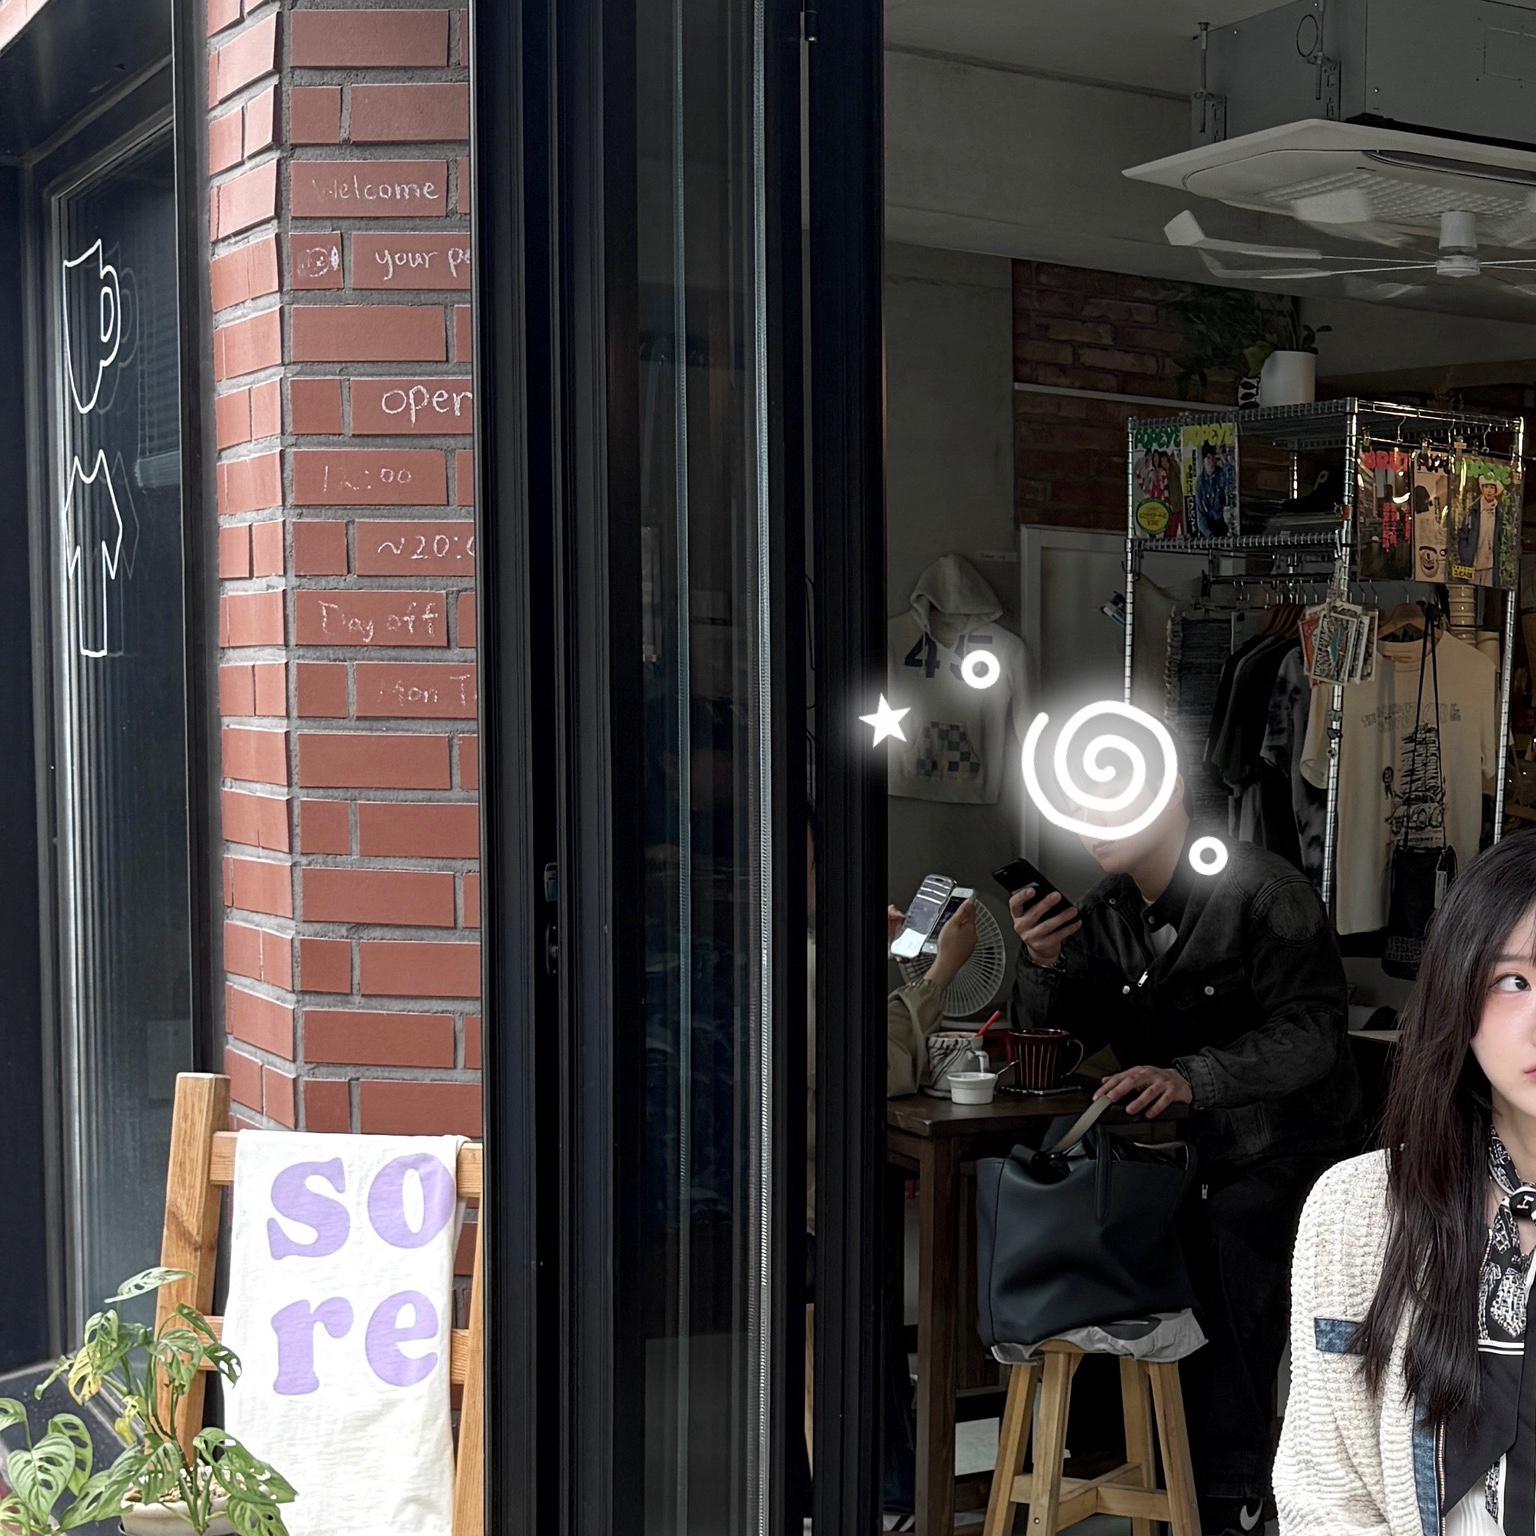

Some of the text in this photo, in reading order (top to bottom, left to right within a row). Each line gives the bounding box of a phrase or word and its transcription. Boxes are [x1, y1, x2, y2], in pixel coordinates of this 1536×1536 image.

[375, 249, 438, 281] your
[266, 1153, 457, 1261] so
[270, 1289, 440, 1396] re
